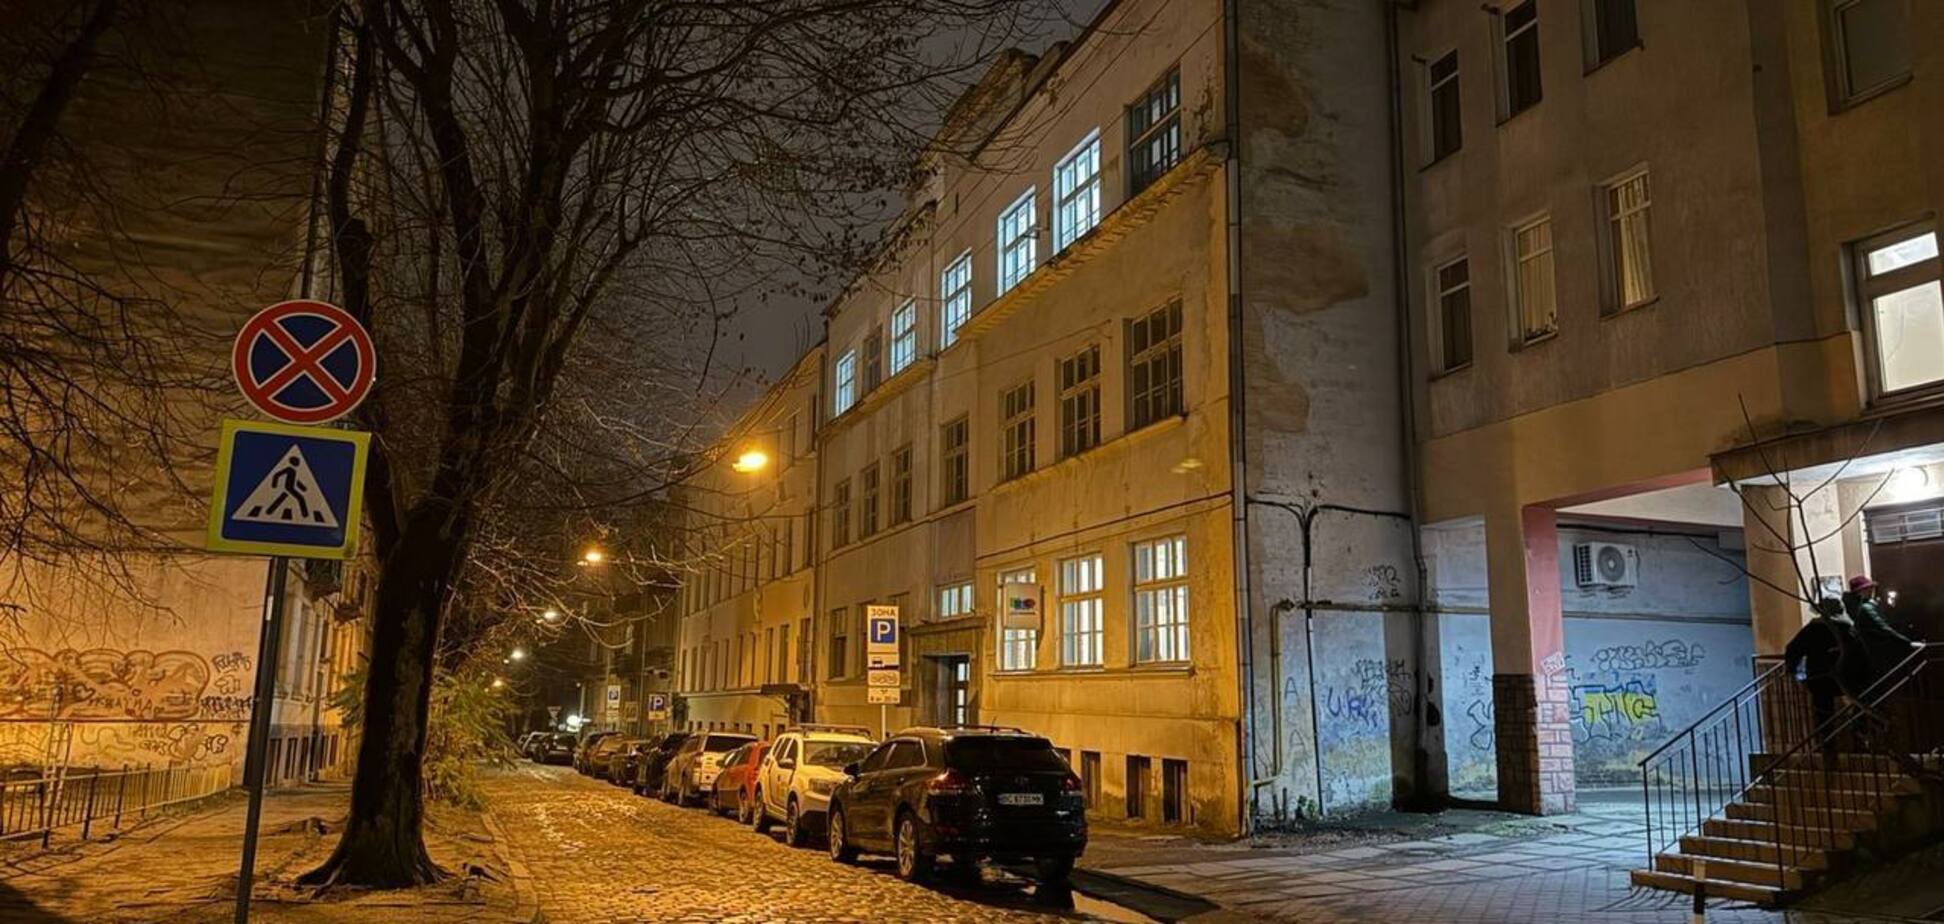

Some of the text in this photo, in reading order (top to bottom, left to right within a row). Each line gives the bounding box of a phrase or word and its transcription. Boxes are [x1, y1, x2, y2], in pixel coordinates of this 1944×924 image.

[871, 607, 896, 617] ЗОНА
[877, 621, 891, 641] P
[653, 695, 664, 710] P
